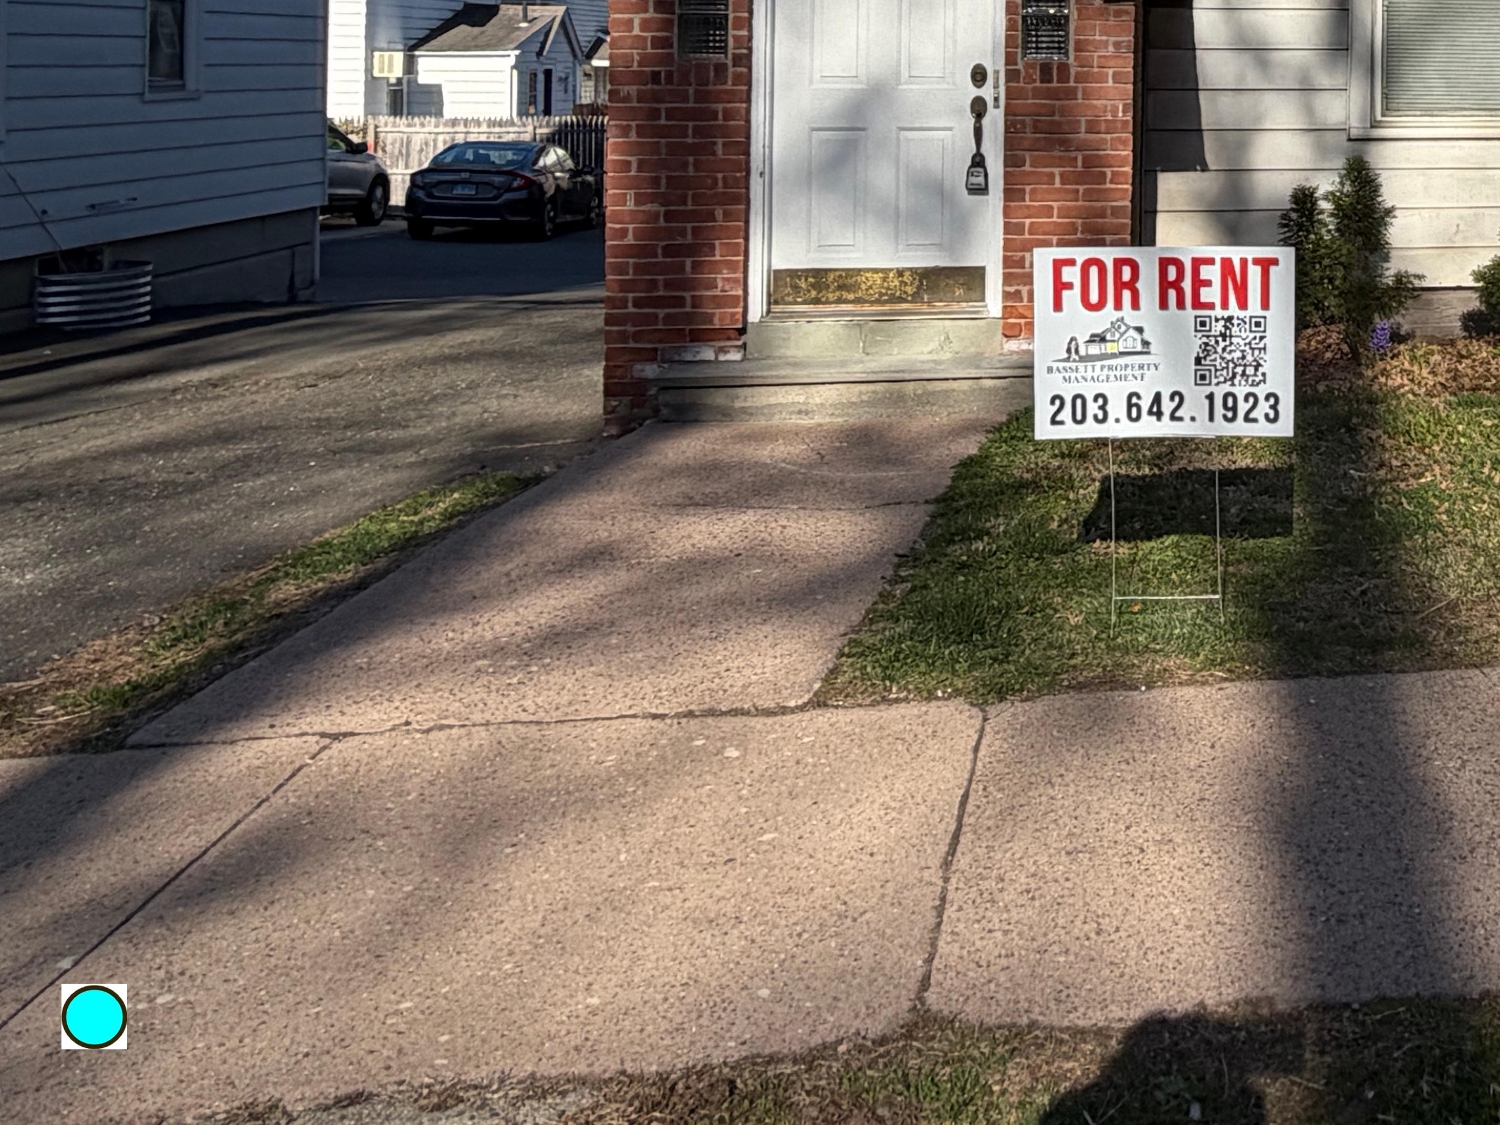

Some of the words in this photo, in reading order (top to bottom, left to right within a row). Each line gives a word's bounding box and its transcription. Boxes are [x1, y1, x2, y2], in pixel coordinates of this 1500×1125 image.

[1052, 257, 1141, 313] FOR
[1158, 256, 1280, 312] RENT
[1046, 364, 1097, 375] BASSETT
[1099, 362, 1161, 373] PROPERTY
[1061, 373, 1147, 385] MANAGEMENT
[1049, 391, 1280, 426] 203.642.1923
